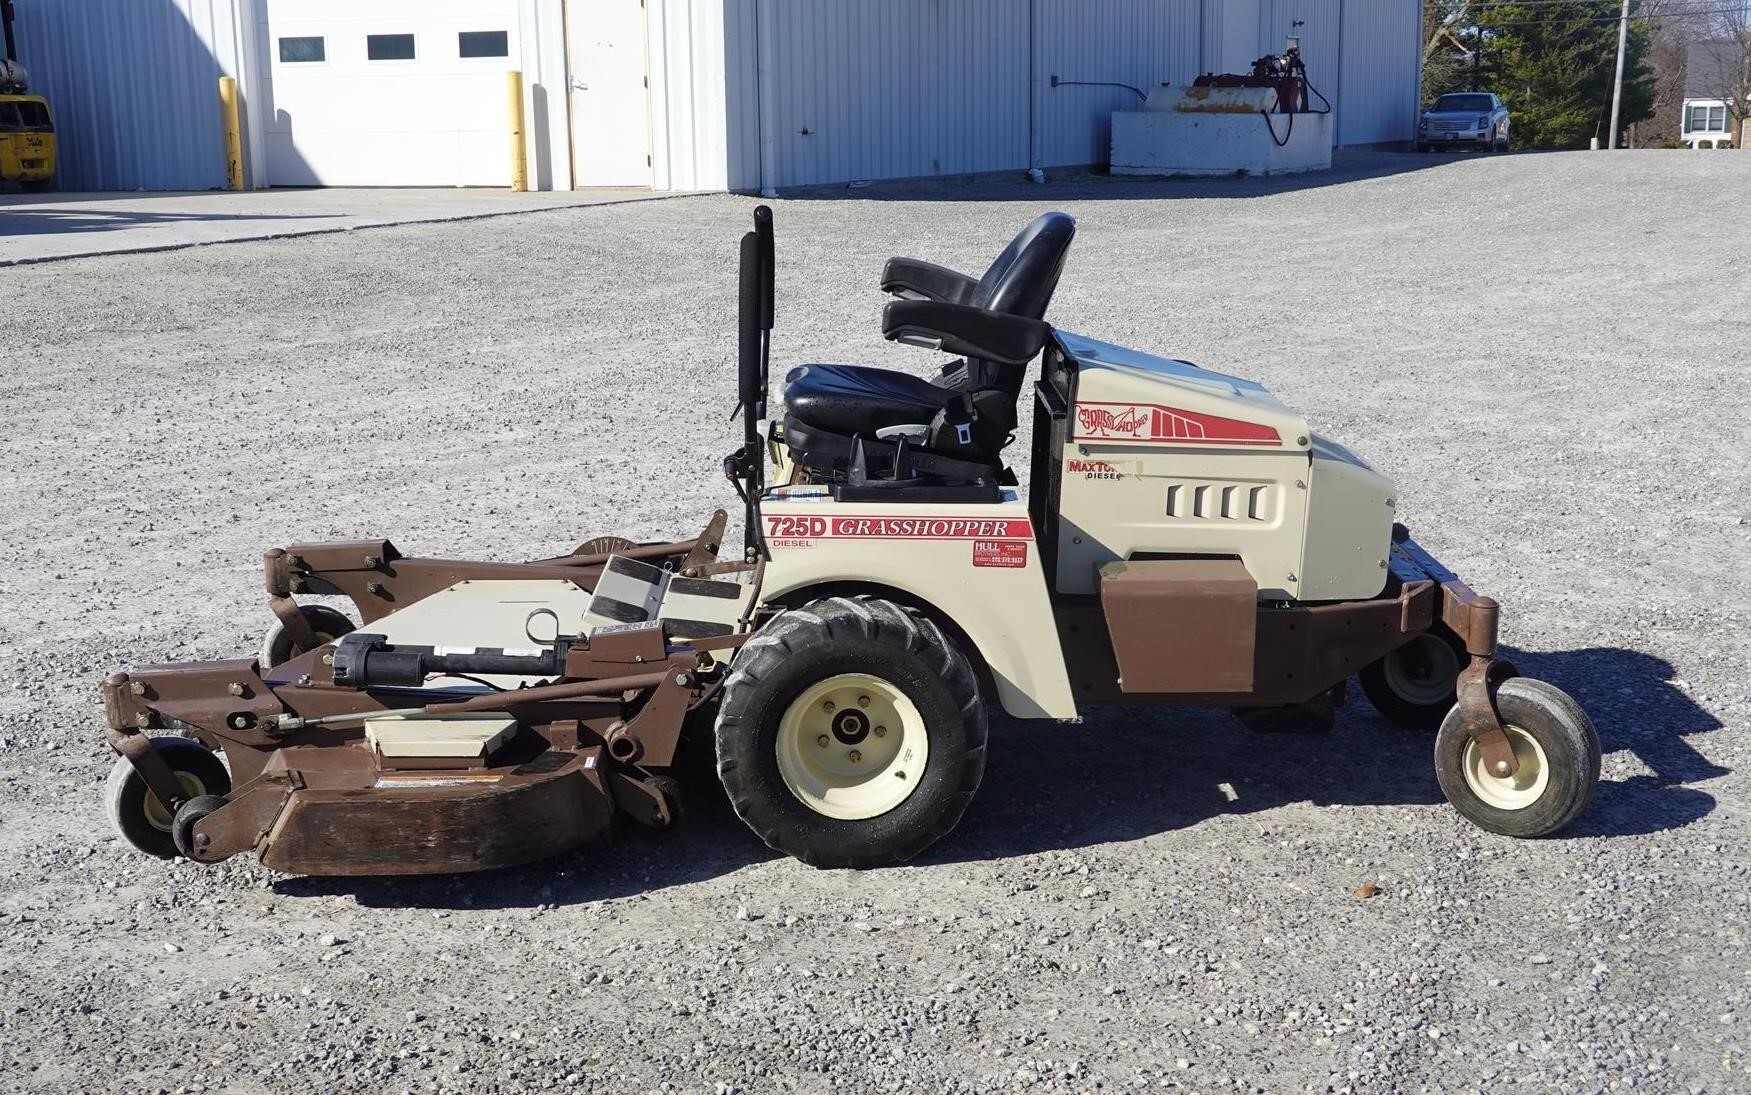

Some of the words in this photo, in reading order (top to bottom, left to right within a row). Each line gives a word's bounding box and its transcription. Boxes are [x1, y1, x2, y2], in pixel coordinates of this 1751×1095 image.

[767, 517, 827, 536] 725D
[839, 519, 1008, 536] GRASSHOPPER
[975, 542, 1000, 551] HULL
